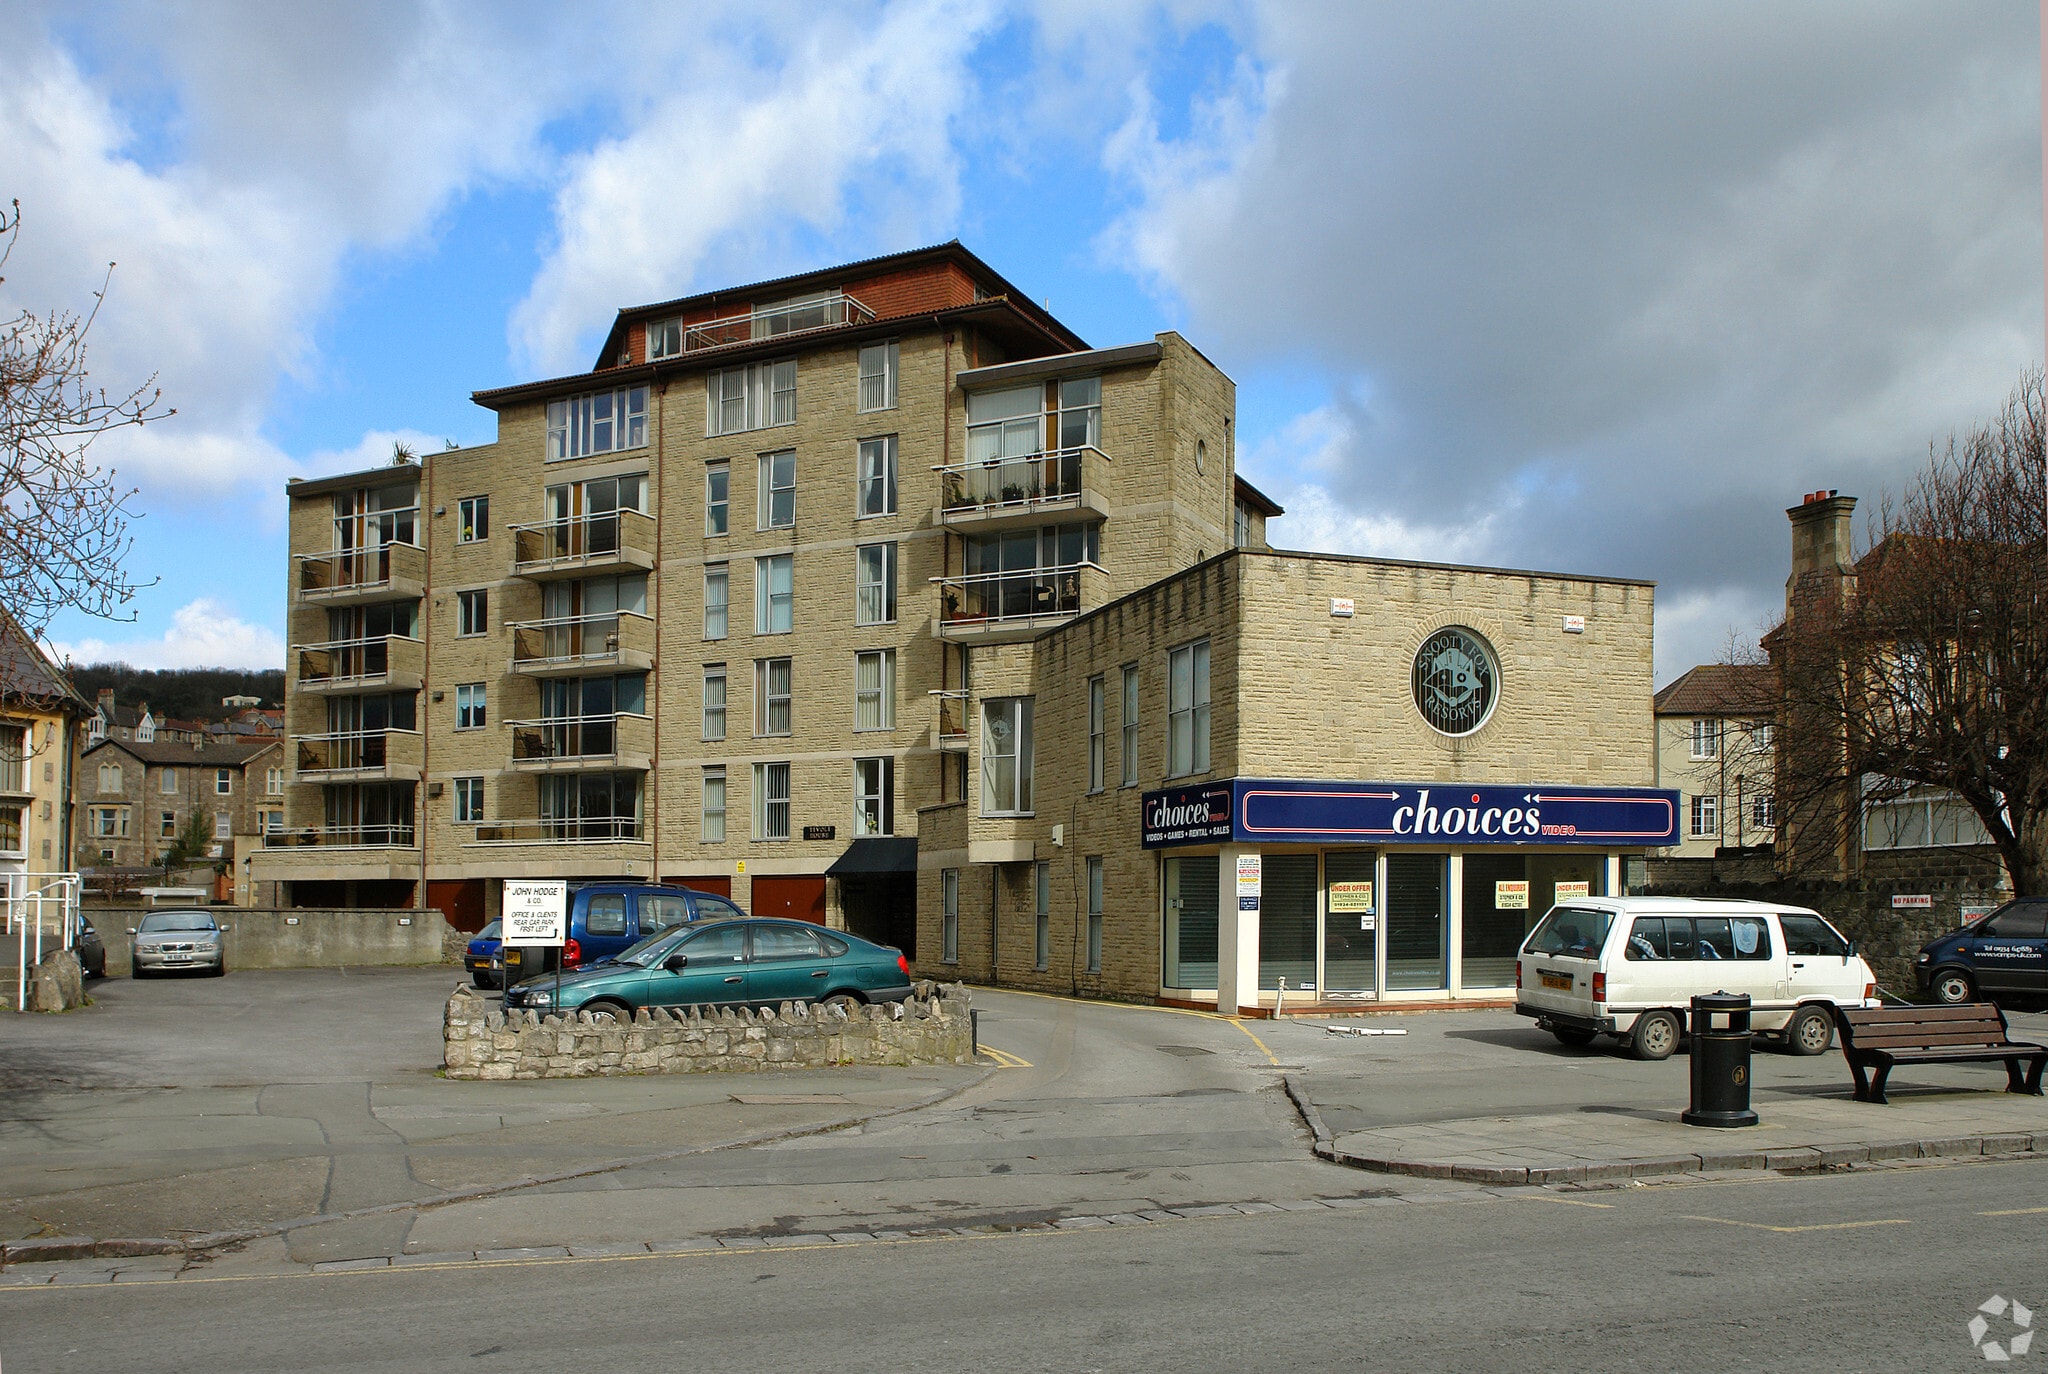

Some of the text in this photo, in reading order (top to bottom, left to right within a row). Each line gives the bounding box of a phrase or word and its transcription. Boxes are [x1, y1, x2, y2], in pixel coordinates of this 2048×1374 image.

[1418, 636, 1489, 677] SNOOTY FOX
[1424, 695, 1481, 720] RESORTS
[1154, 795, 1210, 828] choices
[1392, 789, 1577, 836] choices VIDEO
[1146, 825, 1230, 842] VIDEOS GAMES RENTAL SALES
[512, 887, 558, 896] JOHN HODGE
